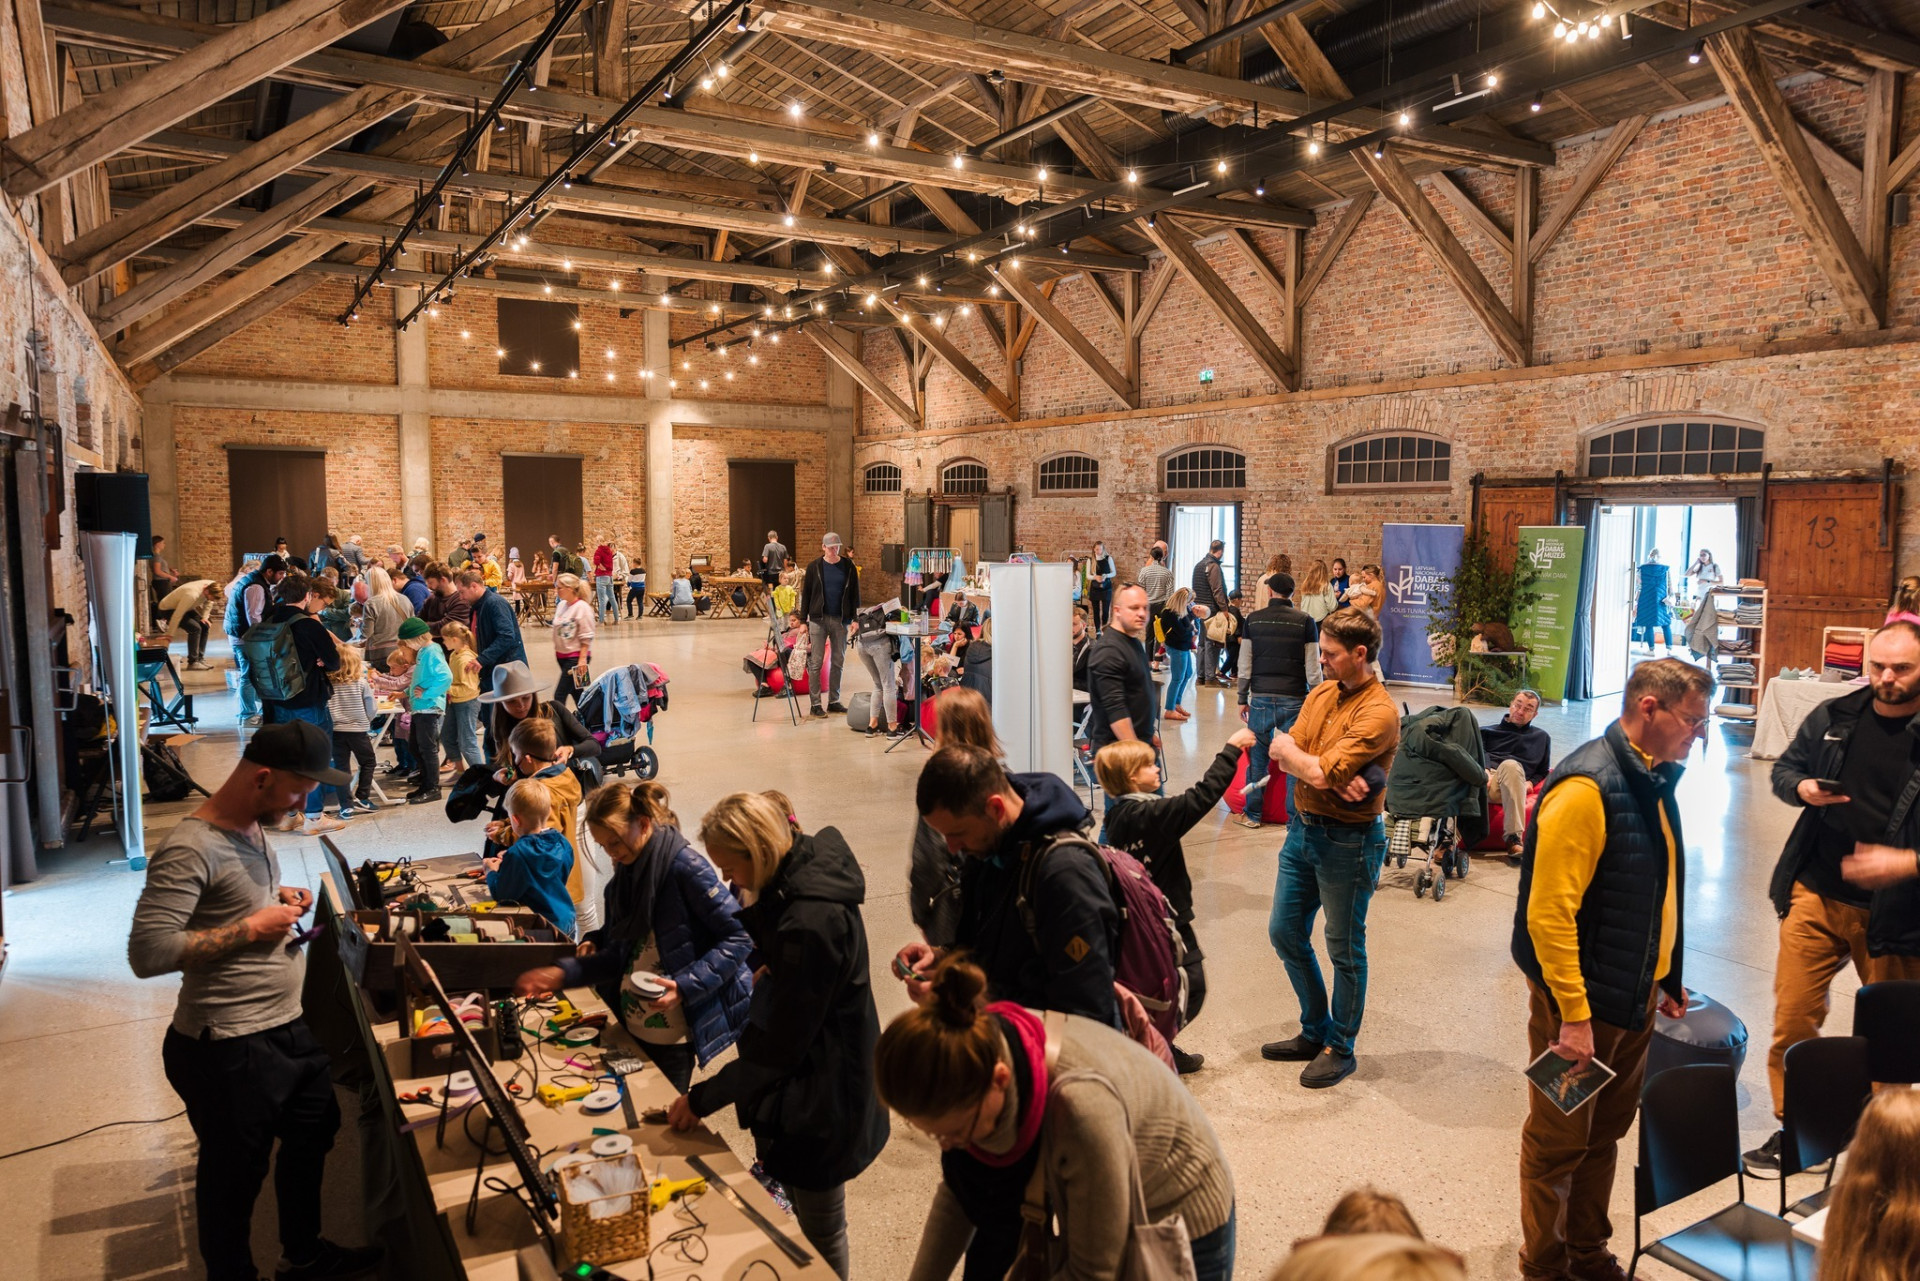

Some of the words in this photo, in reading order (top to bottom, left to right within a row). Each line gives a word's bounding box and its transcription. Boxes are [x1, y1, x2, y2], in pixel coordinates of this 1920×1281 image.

[1807, 514, 1838, 549] 13
[1414, 575, 1446, 584] DABAS
[1413, 583, 1450, 592] MUZEJS
